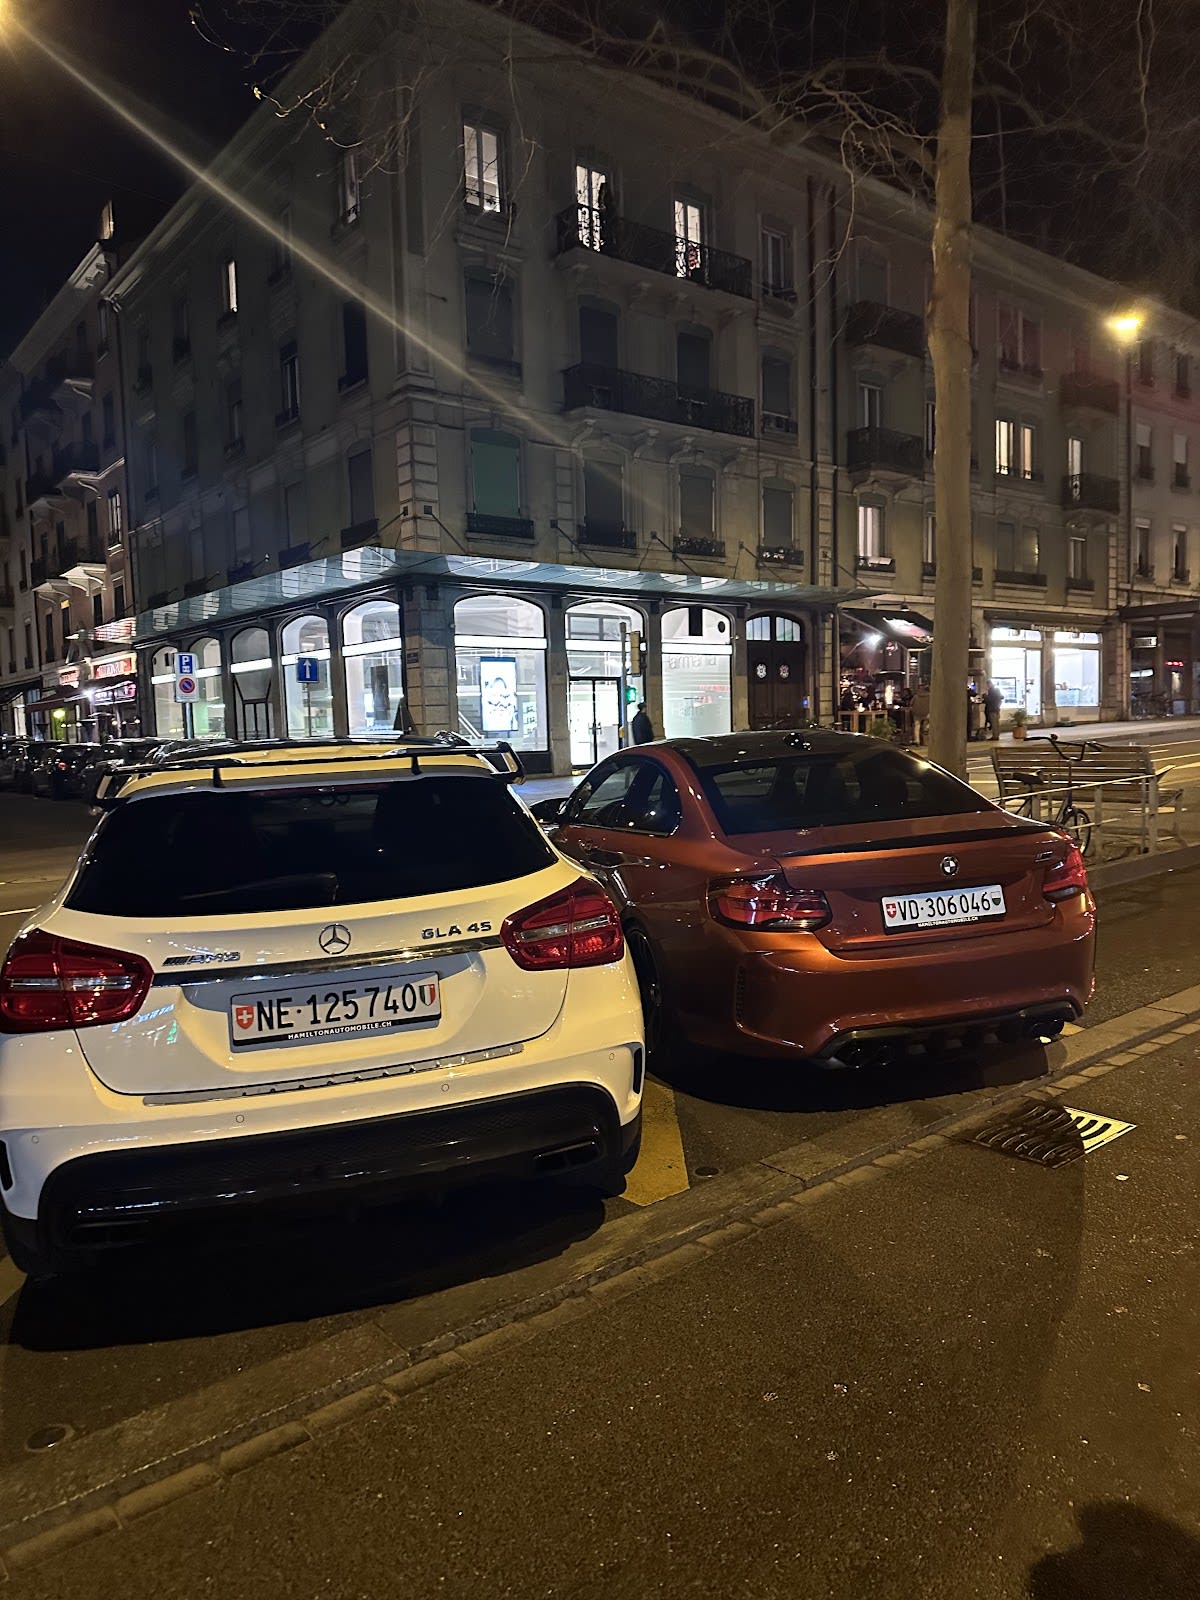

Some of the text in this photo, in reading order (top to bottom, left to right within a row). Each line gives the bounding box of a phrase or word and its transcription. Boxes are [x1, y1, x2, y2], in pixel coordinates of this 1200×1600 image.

[182, 655, 190, 666] P
[421, 921, 492, 940] GLA 45
[287, 1020, 393, 1040] HAMILTONAUTOMOBILE.CH
